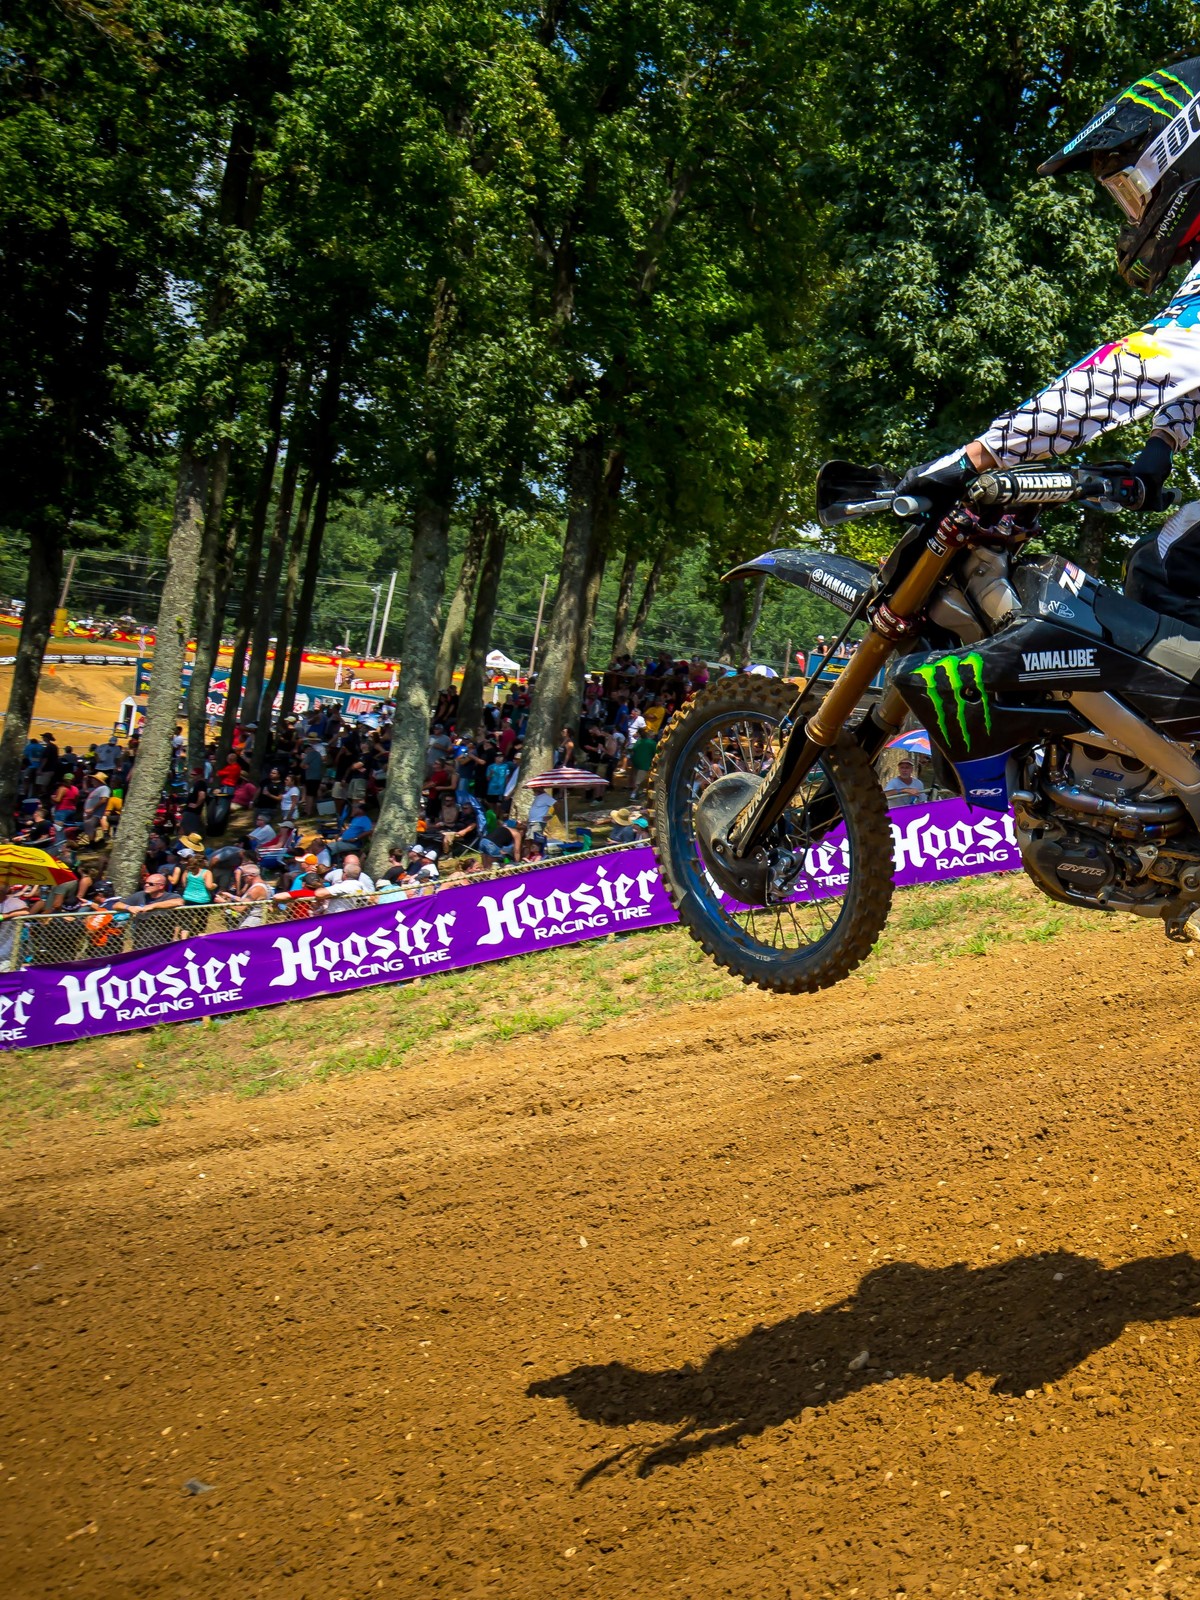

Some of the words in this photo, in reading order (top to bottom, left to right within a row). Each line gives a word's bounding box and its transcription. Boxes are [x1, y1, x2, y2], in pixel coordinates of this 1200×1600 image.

[1155, 191, 1188, 241] MONSTER
[1166, 201, 1189, 238] ENERGY
[822, 572, 858, 602] YAMAHA
[1021, 649, 1095, 671] YAMALUBE
[936, 849, 1010, 871] RACING
[476, 865, 659, 946] Hoosier
[533, 914, 609, 940] RACING
[612, 904, 652, 922] TIRE
[269, 910, 457, 987] Hoosier
[329, 958, 404, 984] RACING
[409, 947, 452, 966] TIRE
[54, 947, 250, 1026] Hoosier
[116, 997, 194, 1023] RACING
[199, 987, 243, 1006] TIRE
